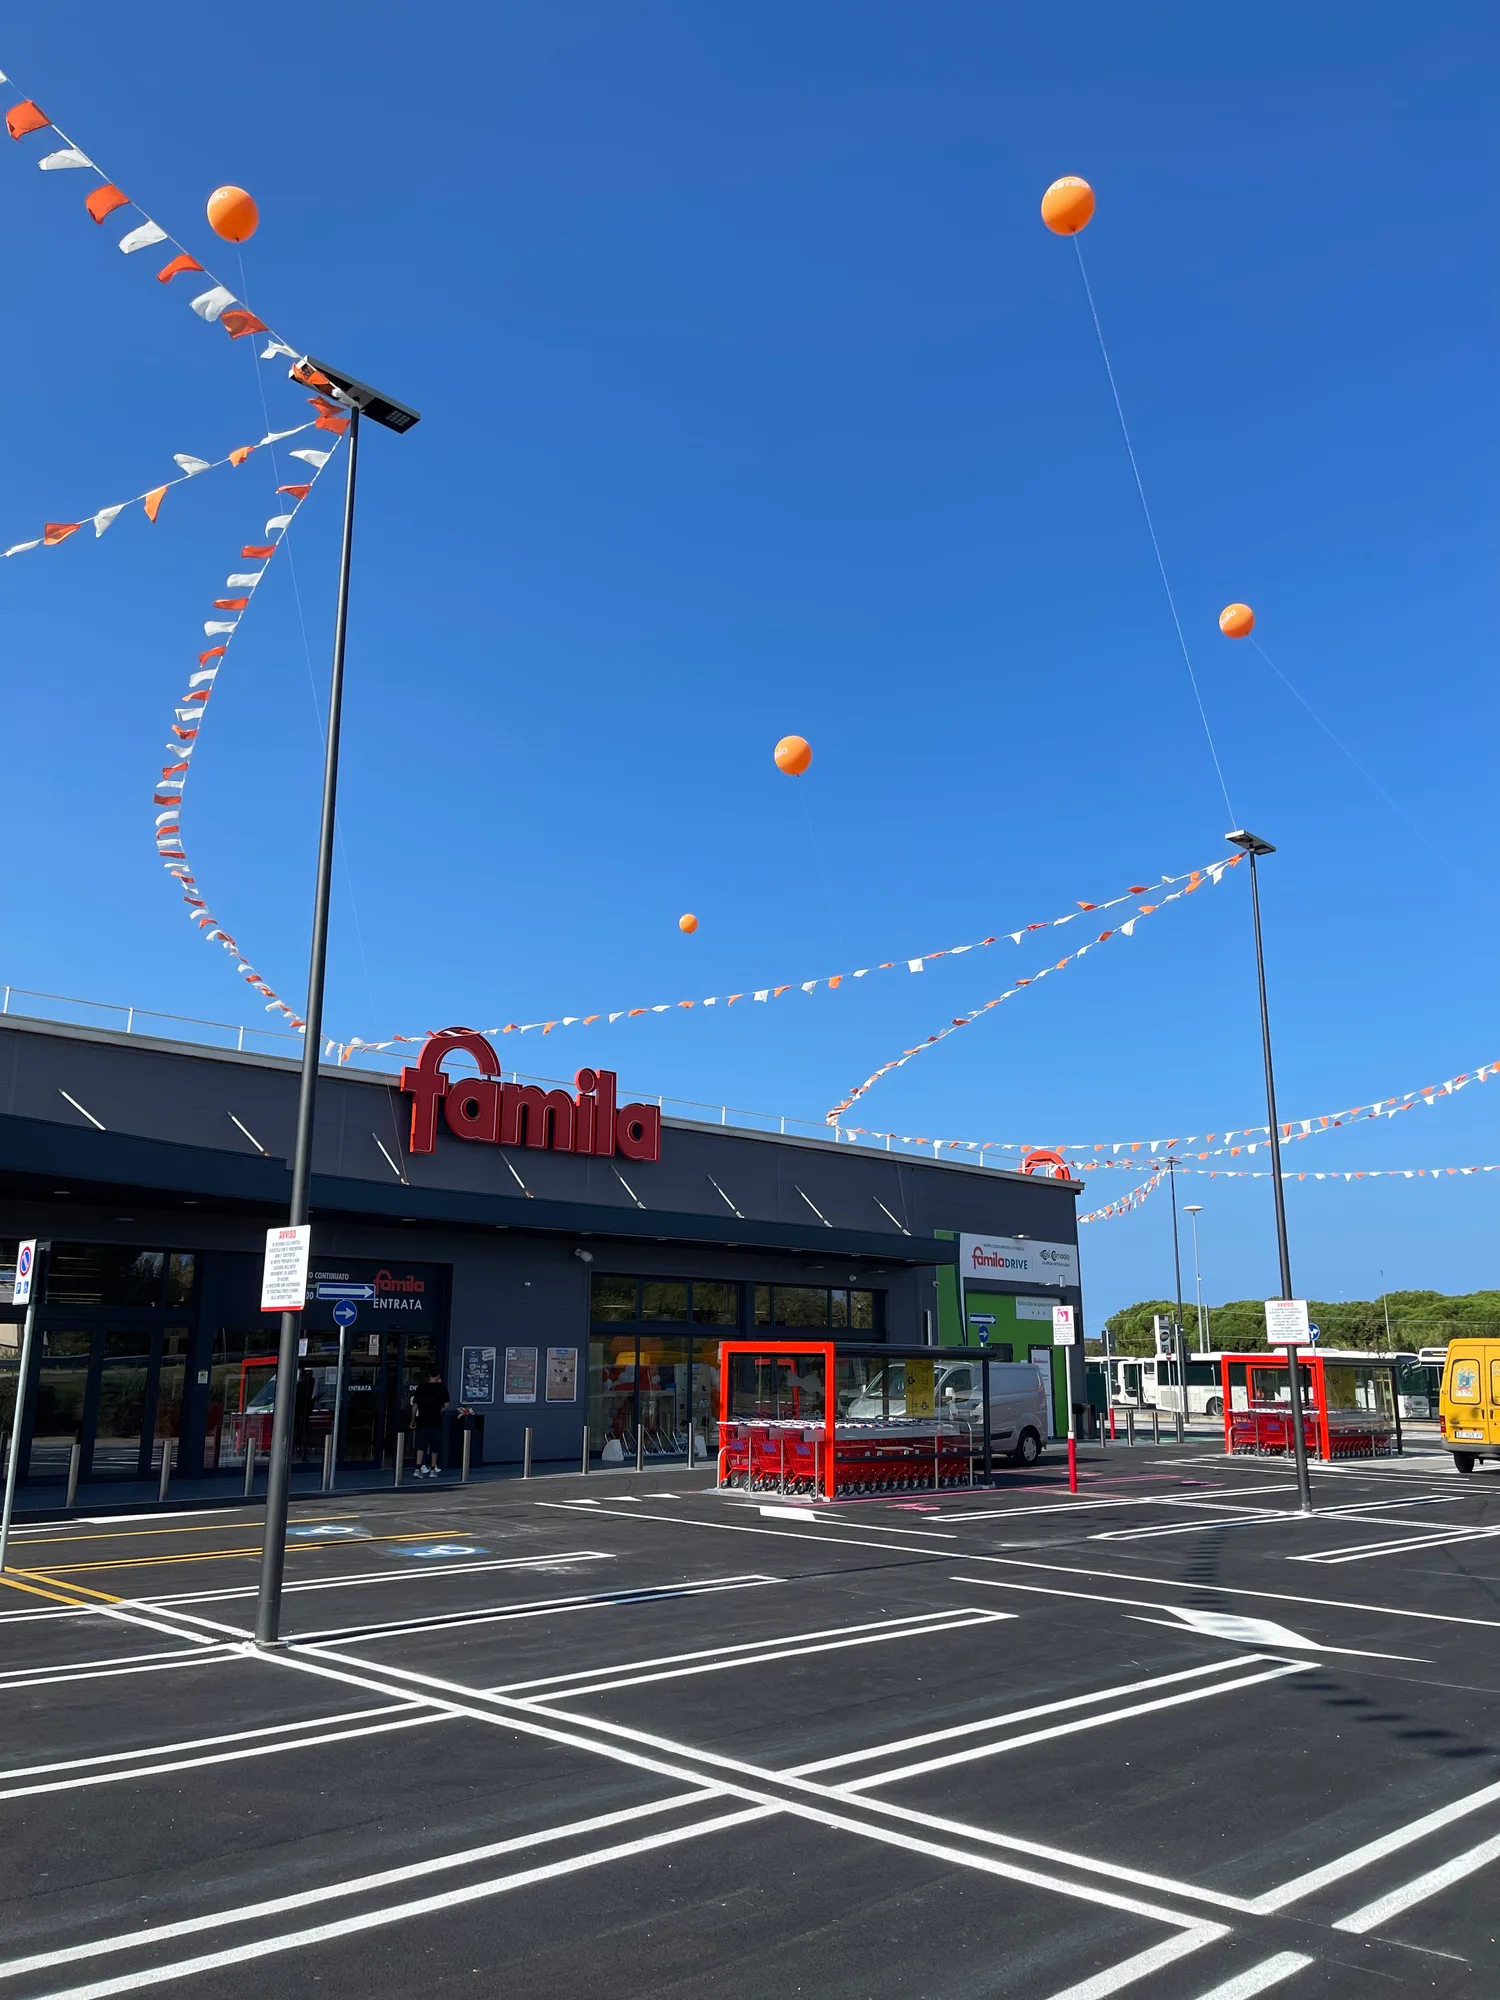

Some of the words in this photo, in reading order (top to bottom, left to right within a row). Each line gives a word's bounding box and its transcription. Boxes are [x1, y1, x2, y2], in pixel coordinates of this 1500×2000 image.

[400, 1026, 661, 1162] famila
[278, 1229, 297, 1240] AVVISO
[314, 1271, 350, 1280] CONTINUATO
[373, 1269, 424, 1295] famila
[372, 1298, 423, 1310] ENTRATA
